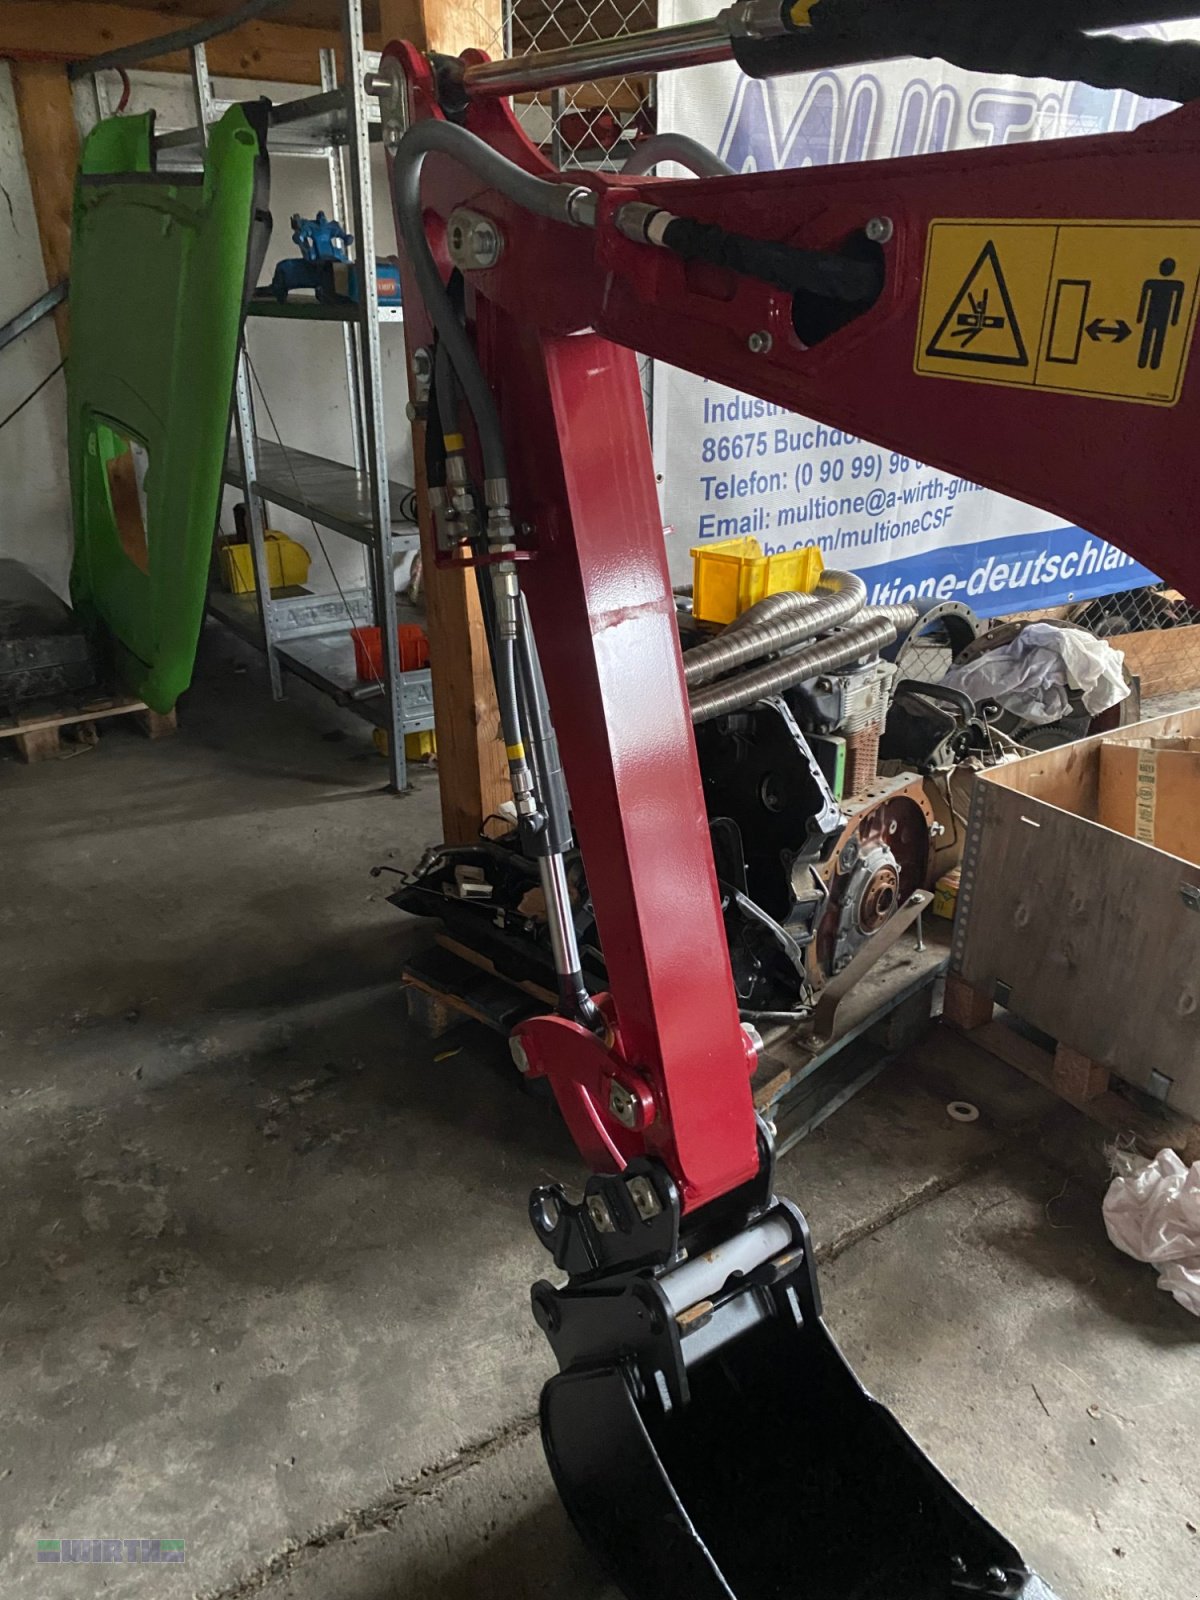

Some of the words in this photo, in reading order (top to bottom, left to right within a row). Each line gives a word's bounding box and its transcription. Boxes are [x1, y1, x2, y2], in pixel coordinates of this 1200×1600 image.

[702, 431, 767, 463] 86675
[774, 424, 862, 454] Buchdo
[700, 470, 788, 501] Telefon:
[795, 462, 813, 493] (0
[820, 458, 844, 484] 90
[851, 454, 882, 482] 99)
[698, 507, 770, 539] Email:
